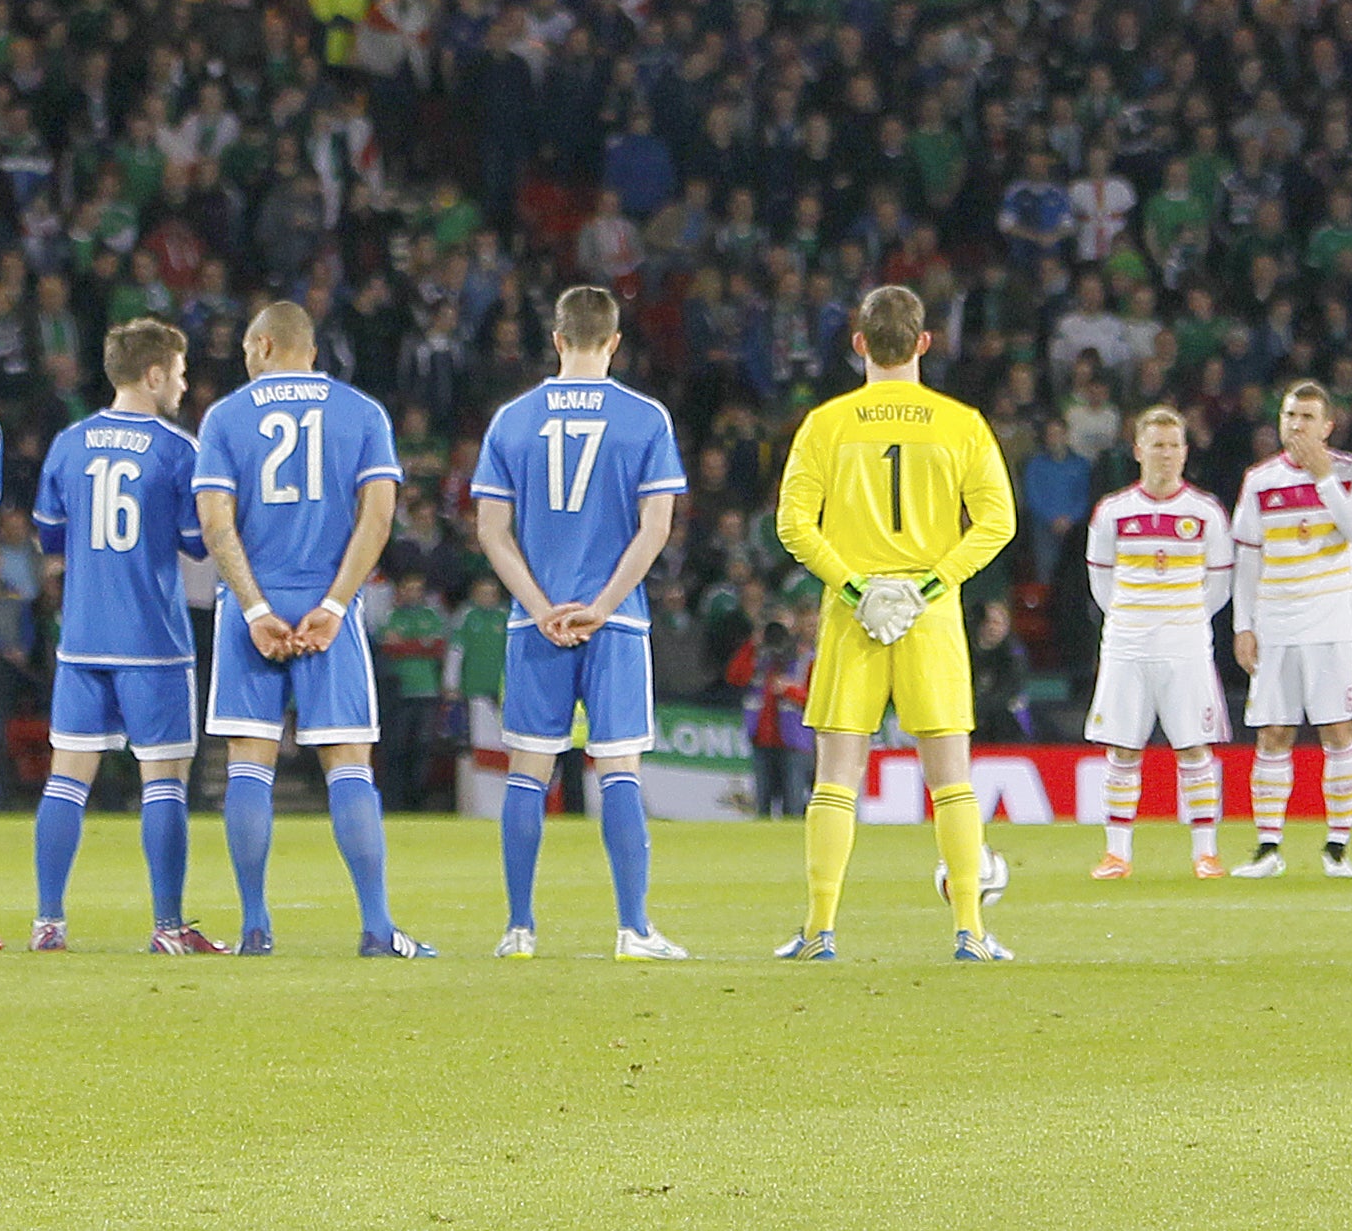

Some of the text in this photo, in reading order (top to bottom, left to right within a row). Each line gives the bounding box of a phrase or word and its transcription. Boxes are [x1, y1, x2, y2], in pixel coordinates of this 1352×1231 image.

[251, 384, 330, 406] MAGENNIS
[546, 392, 604, 411] McNAIR
[855, 404, 934, 424] McGOVERN
[85, 428, 152, 454] NORWOOD
[258, 409, 323, 504] 21
[539, 418, 608, 512] 17
[881, 444, 902, 532] 1
[85, 457, 142, 553] 16
[1155, 550, 1167, 575] 8
